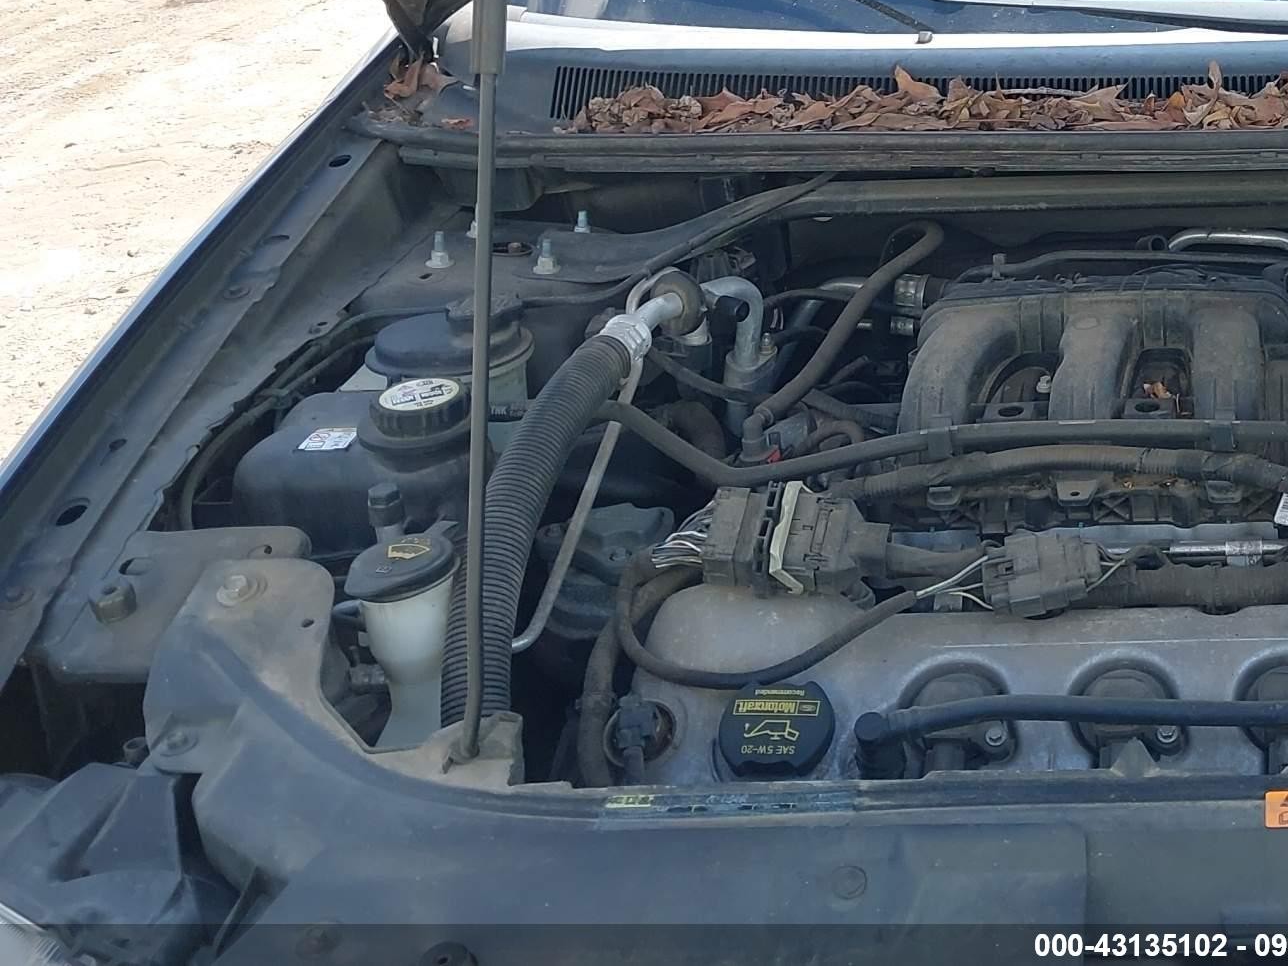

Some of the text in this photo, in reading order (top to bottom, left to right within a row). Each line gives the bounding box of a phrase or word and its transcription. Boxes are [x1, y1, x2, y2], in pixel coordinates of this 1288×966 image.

[738, 701, 796, 713] Motorcraft
[741, 745, 796, 754] SAE 5W-20
